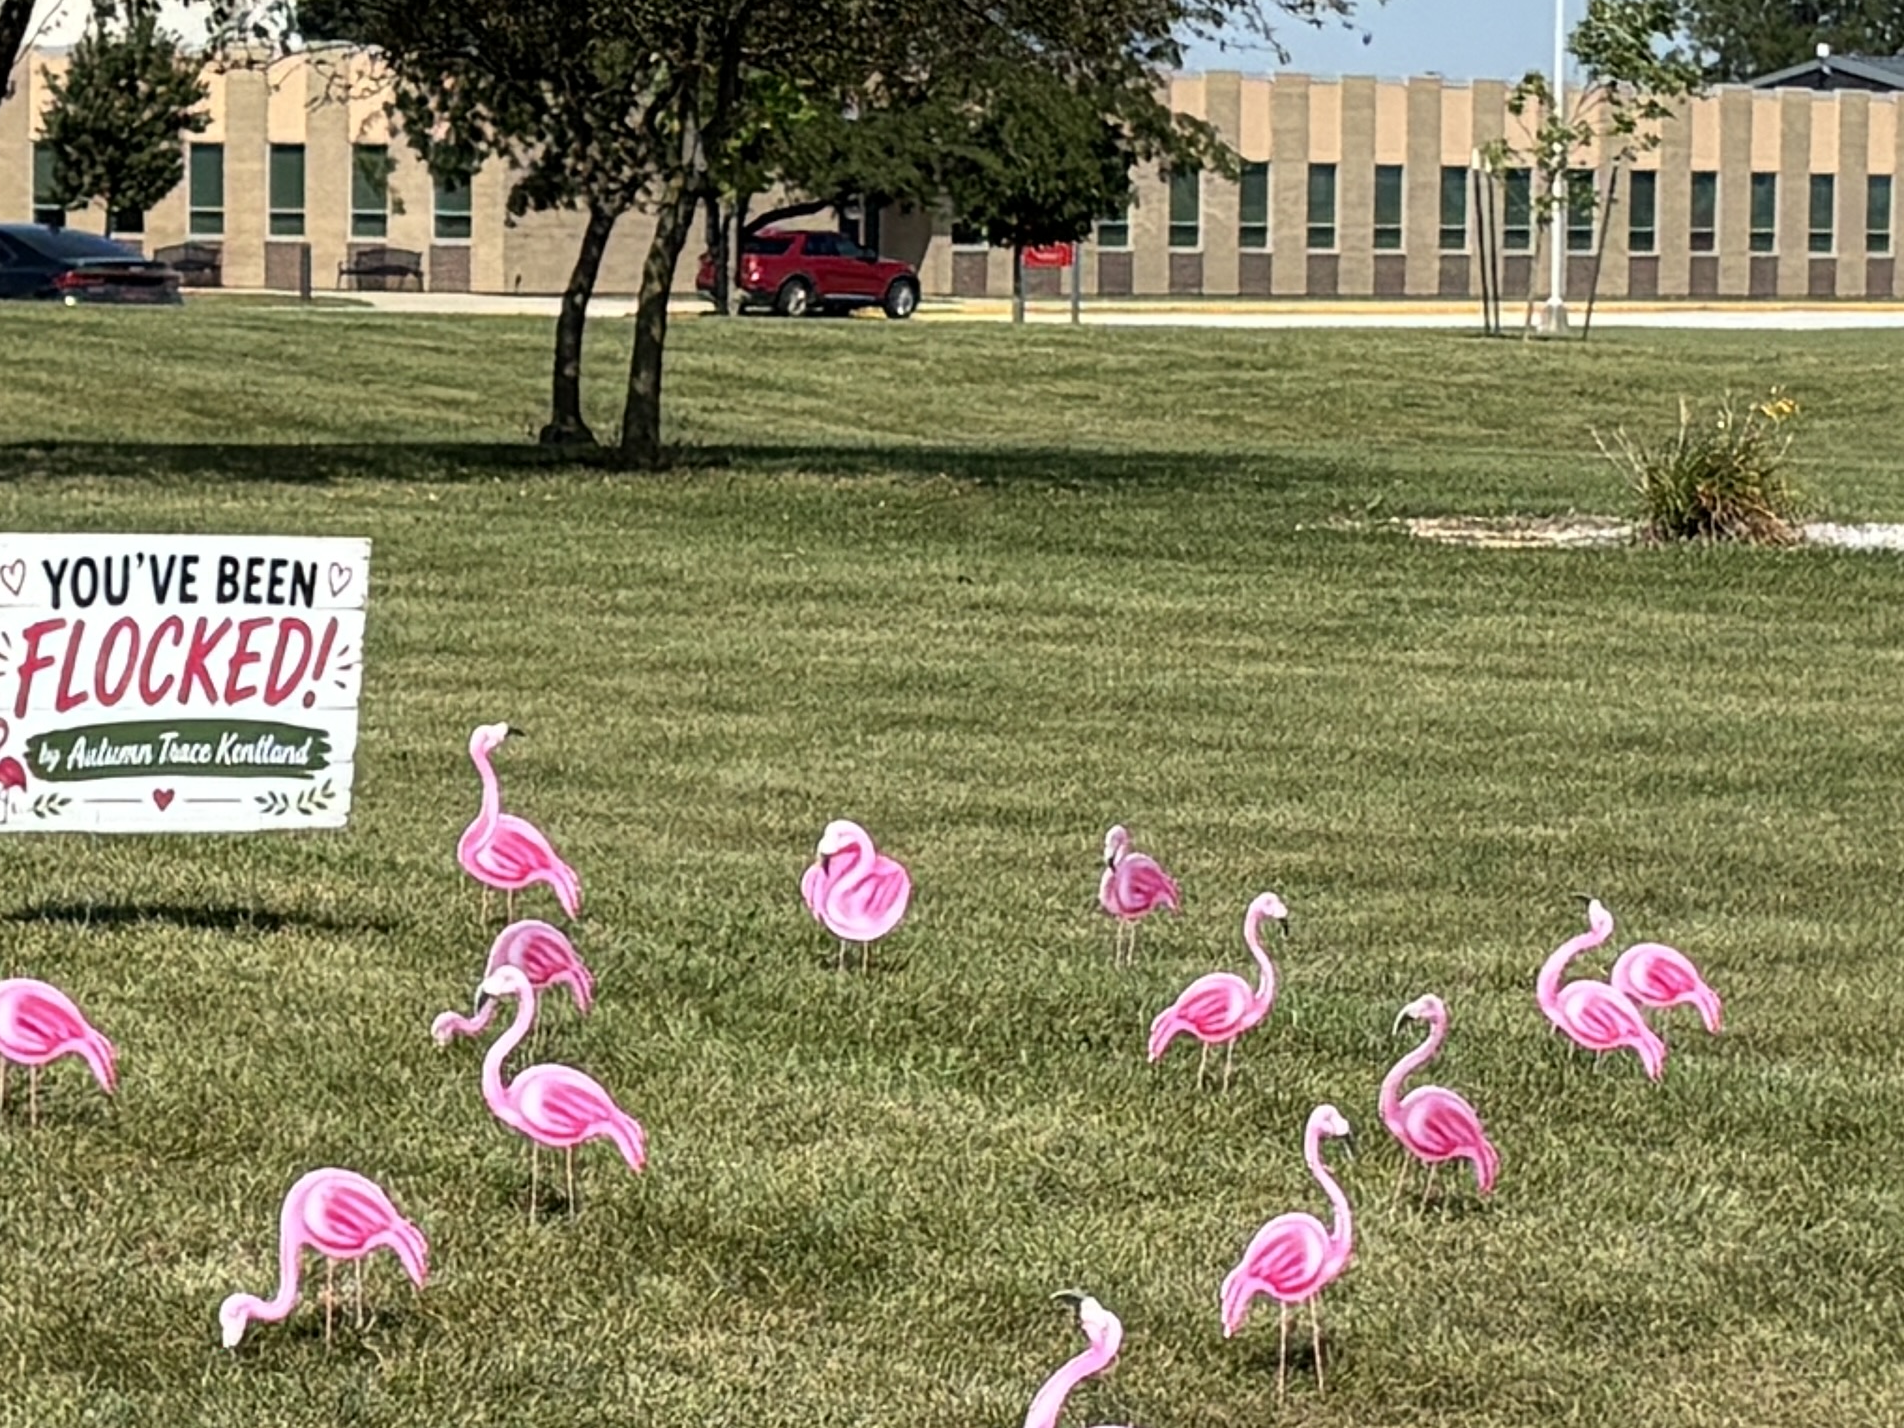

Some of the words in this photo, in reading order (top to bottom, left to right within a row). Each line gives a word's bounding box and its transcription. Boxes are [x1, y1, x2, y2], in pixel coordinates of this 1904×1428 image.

[41, 552, 199, 610] YOU'VE
[215, 556, 318, 609] BEEN
[13, 614, 339, 720] FLOCKED!
[38, 741, 61, 772] by
[66, 735, 153, 771] Autumn
[157, 731, 214, 765] Trace
[215, 731, 313, 766] Kentland
